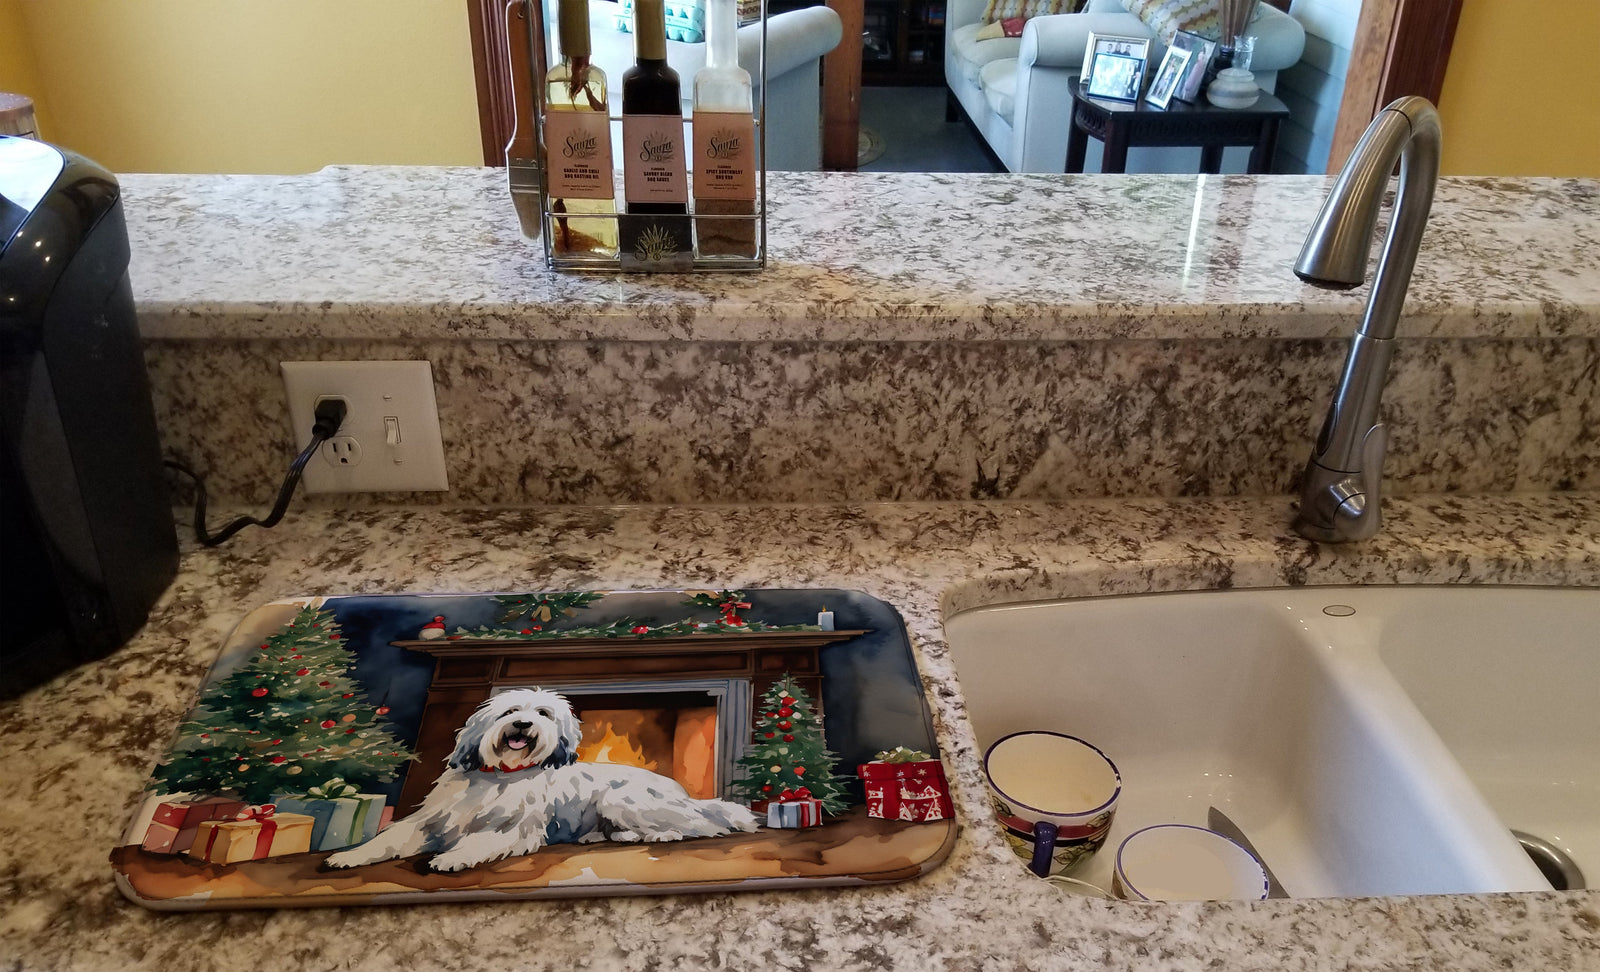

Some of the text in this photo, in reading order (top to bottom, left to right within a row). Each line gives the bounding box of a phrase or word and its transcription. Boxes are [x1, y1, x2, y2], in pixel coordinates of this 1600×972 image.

[563, 136, 597, 158] Sauza
[640, 140, 673, 162] Sauza
[707, 137, 740, 158] Sauza
